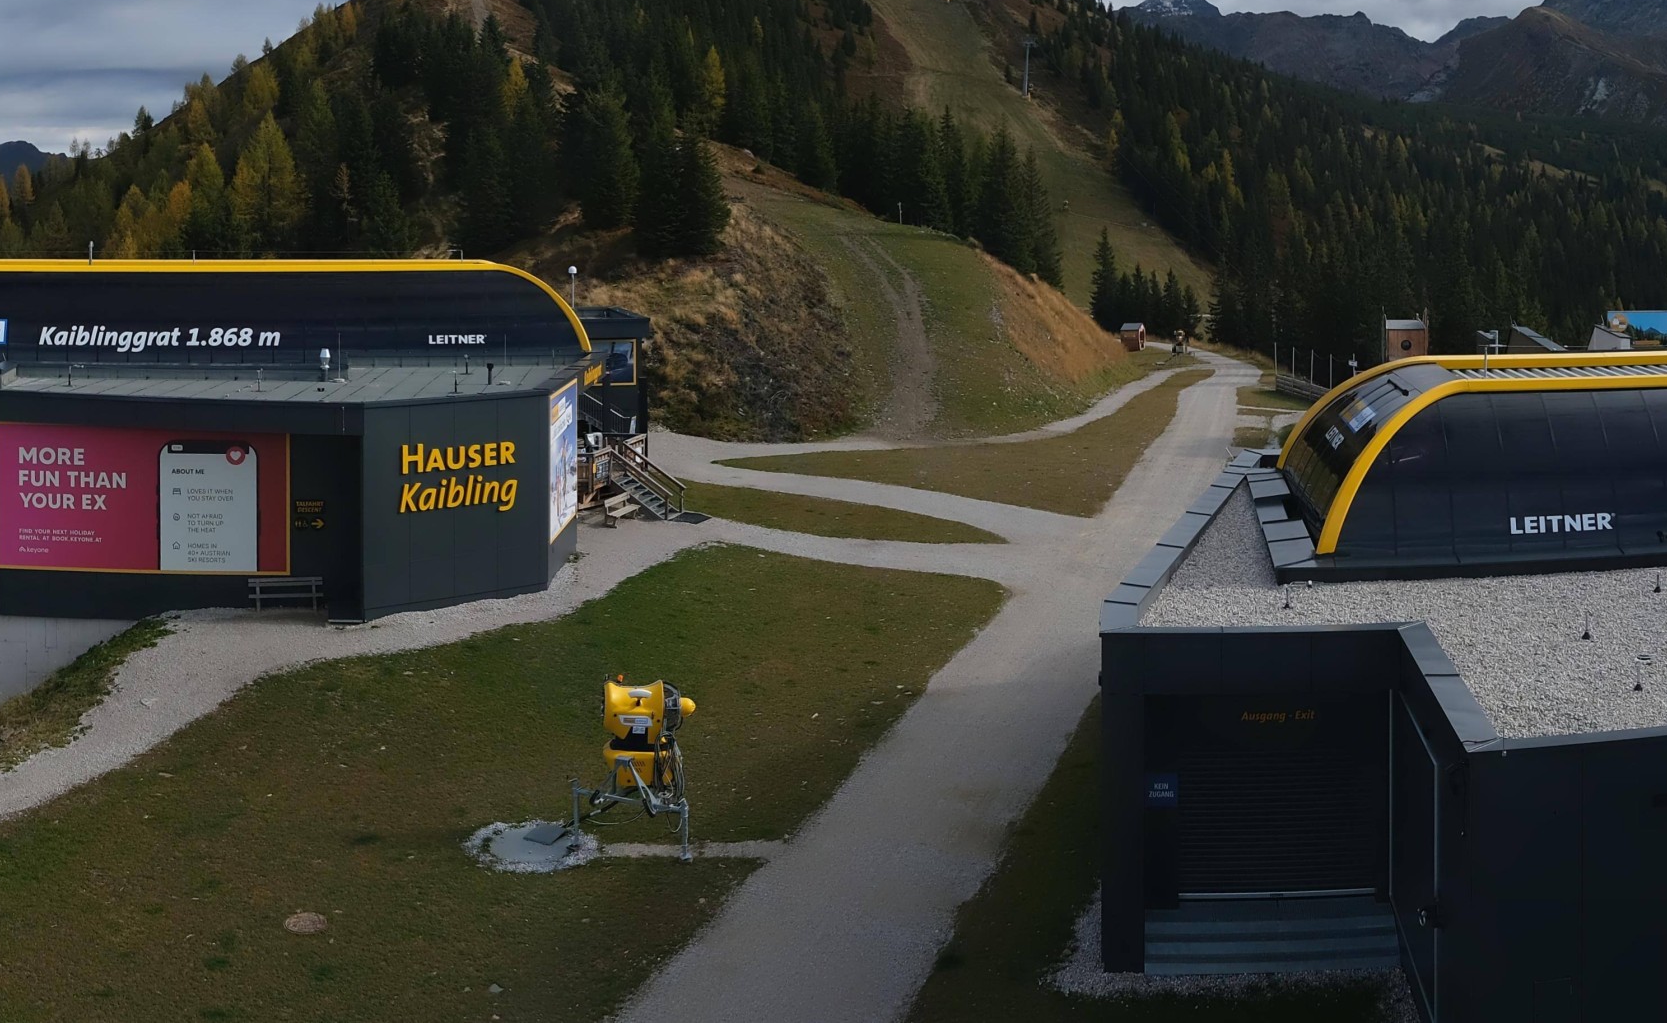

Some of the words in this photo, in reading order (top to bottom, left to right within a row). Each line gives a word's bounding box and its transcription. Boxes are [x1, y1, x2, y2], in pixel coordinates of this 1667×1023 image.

[38, 325, 181, 352] Kaiblinggrat
[186, 327, 253, 346] 1.868
[258, 330, 281, 346] m
[428, 334, 486, 345] LEITNER
[18, 447, 85, 465] MORE
[401, 441, 517, 475] HAUSER
[18, 470, 60, 487] FUN
[67, 471, 127, 488] THAN
[19, 492, 75, 509] YOUR
[81, 494, 107, 510] EX
[399, 475, 518, 514] Kaibling
[1510, 513, 1613, 534] LEITNER
[26, 546, 49, 554] keyone
[1241, 711, 1286, 723] Ausgang
[1294, 709, 1315, 720] Exit
[1154, 782, 1169, 790] KEIN
